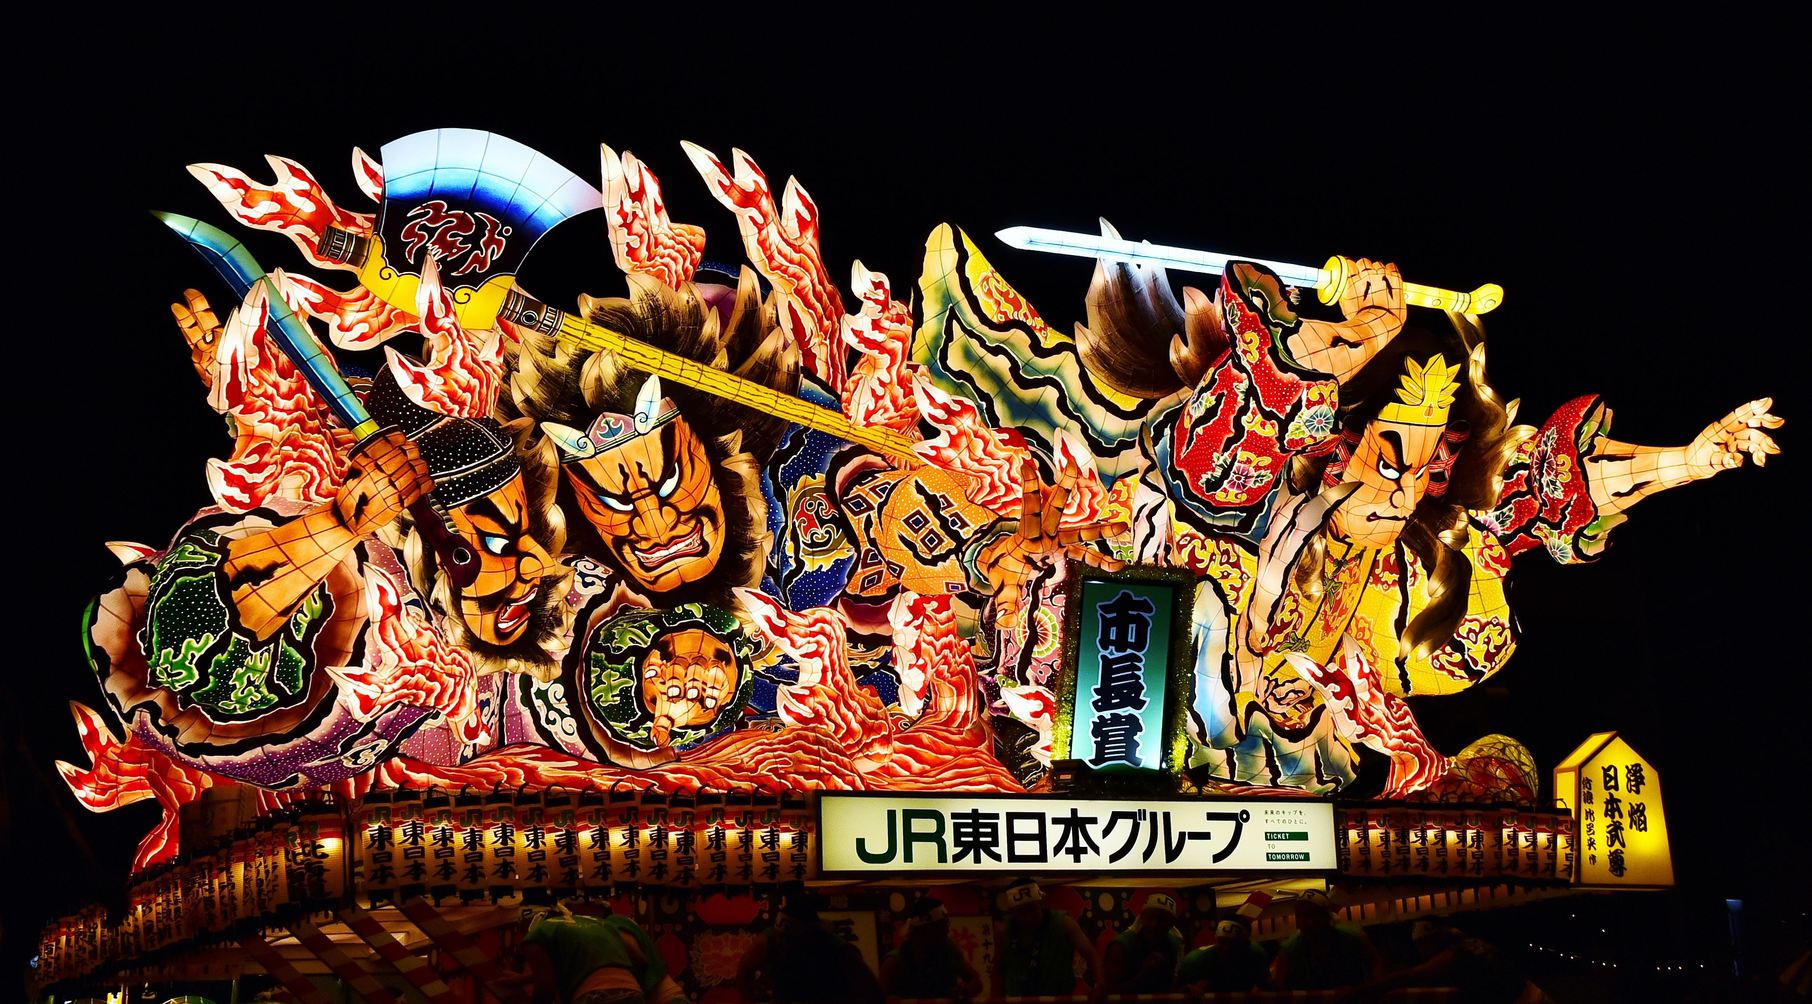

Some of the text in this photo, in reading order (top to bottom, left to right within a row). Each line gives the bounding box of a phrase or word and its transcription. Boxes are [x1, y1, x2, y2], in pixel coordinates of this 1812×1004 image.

[1088, 590, 1155, 768] 市長賞
[855, 807, 1251, 865] JR東日本グループ
[1601, 764, 1627, 878] 日本武尊
